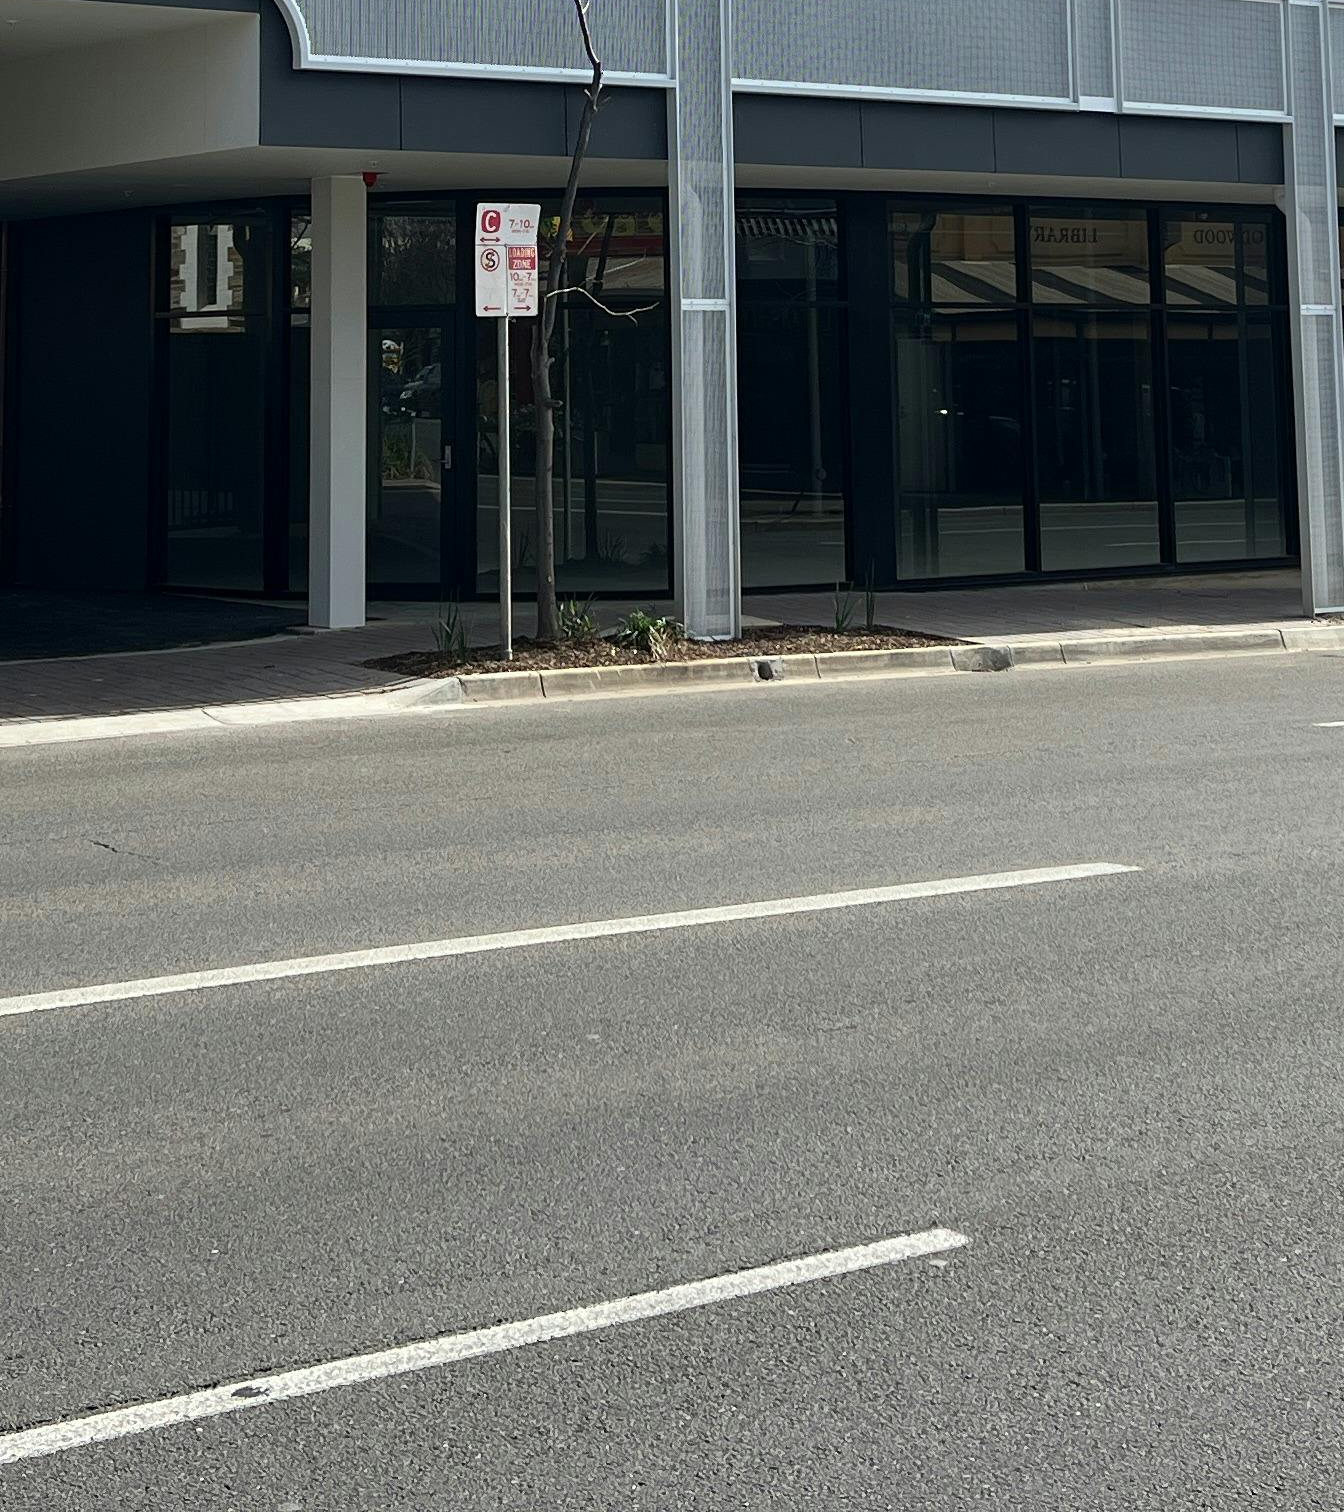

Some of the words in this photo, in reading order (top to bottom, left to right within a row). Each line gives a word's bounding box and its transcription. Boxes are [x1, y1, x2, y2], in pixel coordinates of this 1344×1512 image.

[485, 211, 497, 231] C
[509, 247, 536, 258] LOADING
[484, 252, 496, 269] S
[512, 259, 532, 269] ZONE
